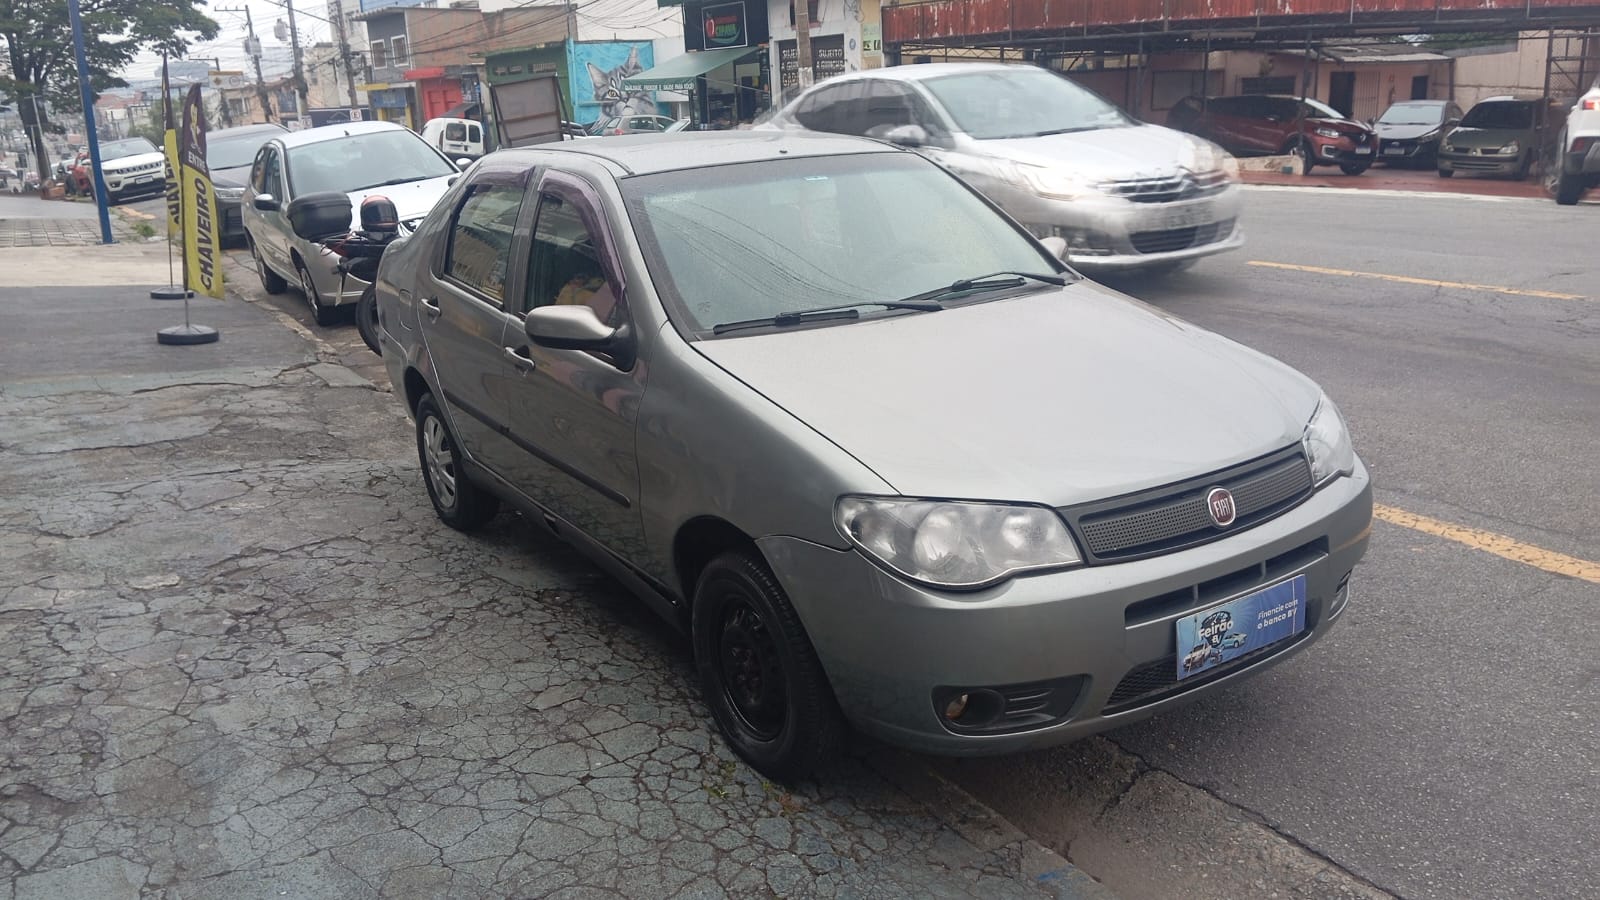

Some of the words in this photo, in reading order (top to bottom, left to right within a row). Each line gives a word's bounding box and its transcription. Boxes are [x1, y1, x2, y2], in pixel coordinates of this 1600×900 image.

[818, 48, 843, 58] SUJEITO
[195, 177, 214, 291] CHAVEIRO
[1213, 498, 1231, 518] FIAT
[1258, 603, 1285, 620] Financie
[1284, 599, 1299, 610] com
[1198, 619, 1234, 639] Feirão
[1257, 622, 1263, 630] o
[1263, 613, 1287, 627] banco
